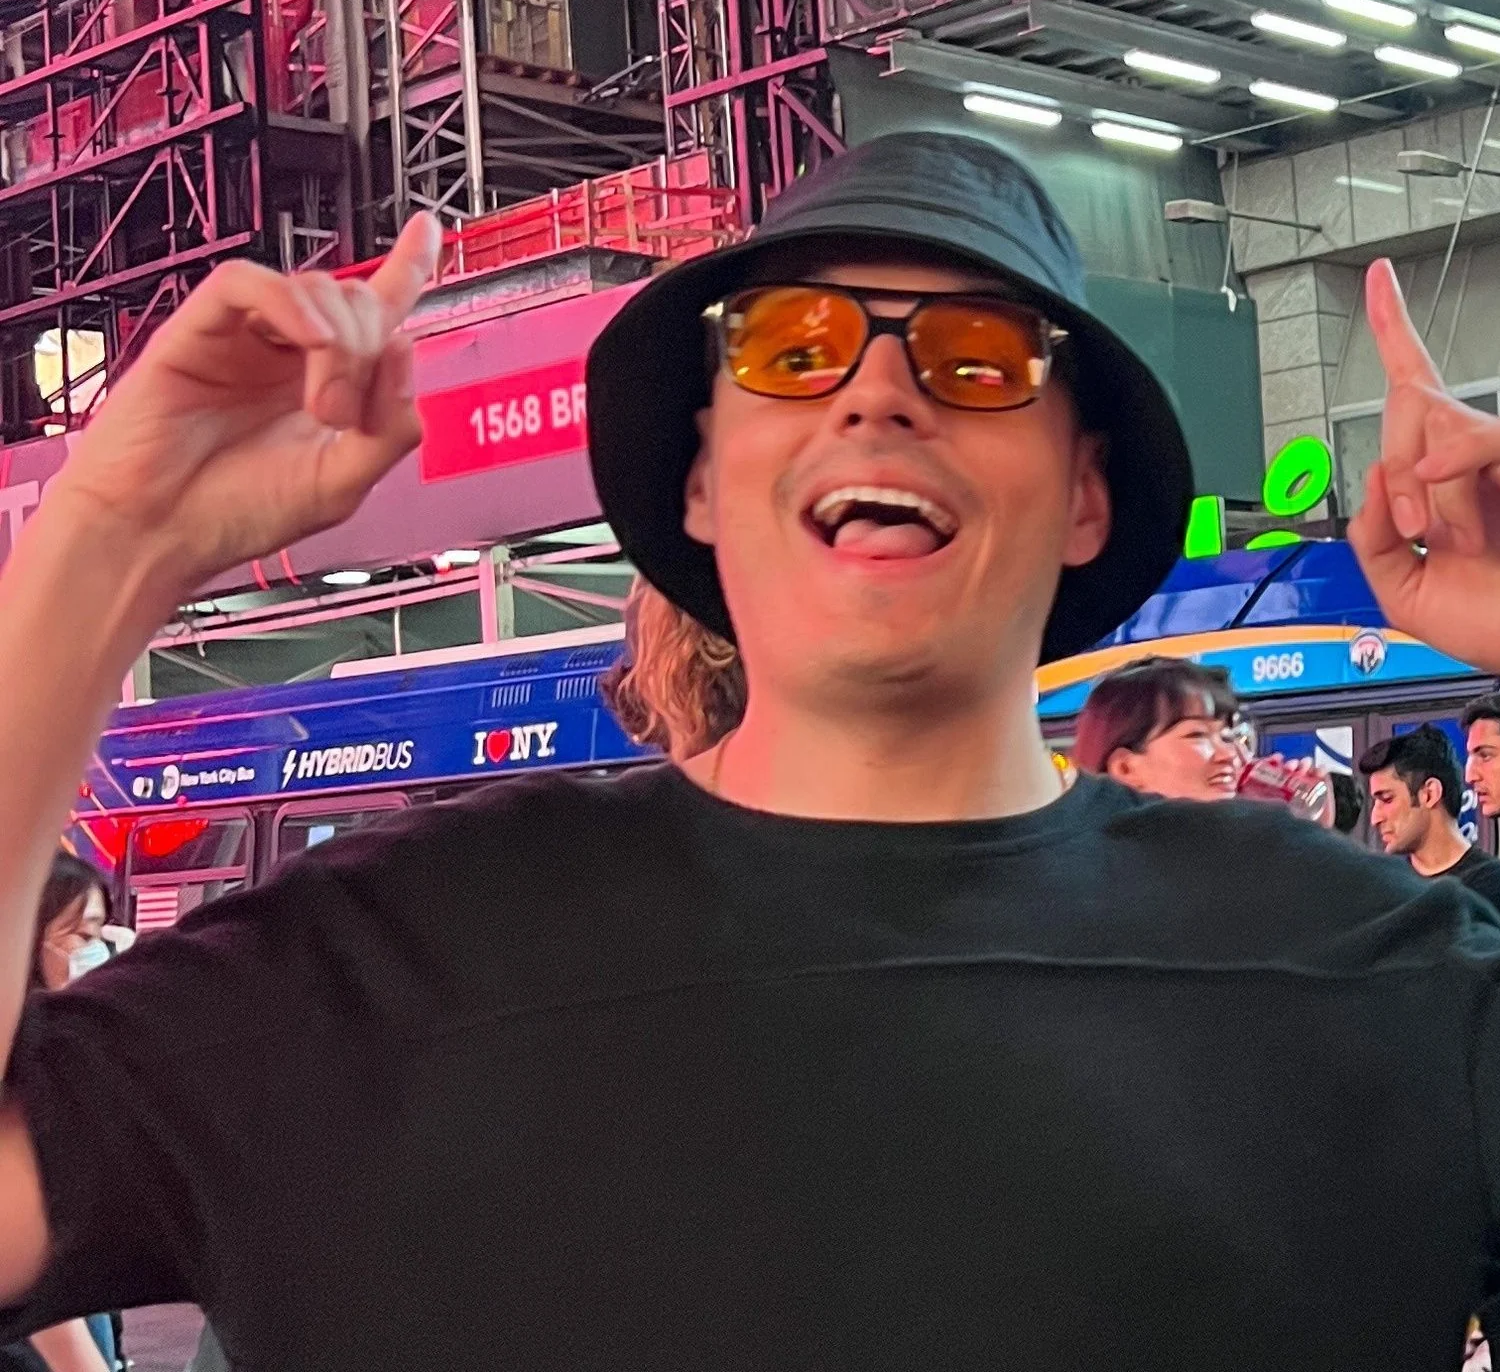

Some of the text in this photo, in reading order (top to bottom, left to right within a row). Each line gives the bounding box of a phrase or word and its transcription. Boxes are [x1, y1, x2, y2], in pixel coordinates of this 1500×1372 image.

[470, 394, 541, 446] 1568
[1252, 651, 1304, 681] 9666
[299, 740, 414, 779] HYBRIDBUS
[473, 721, 558, 765] I NY
